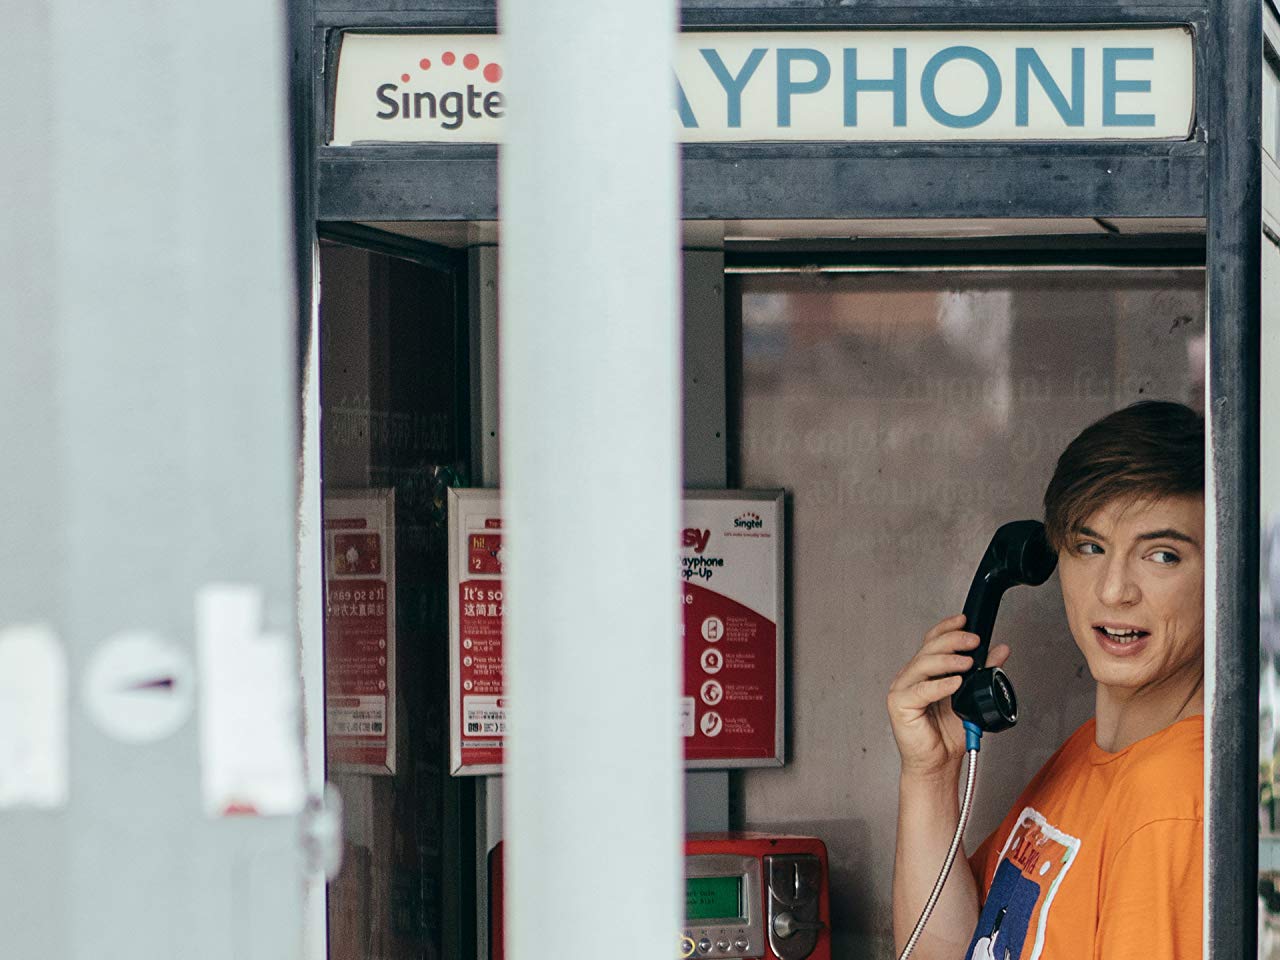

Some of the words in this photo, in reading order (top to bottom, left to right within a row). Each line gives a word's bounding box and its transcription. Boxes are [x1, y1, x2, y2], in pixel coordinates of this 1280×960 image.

[680, 46, 1156, 129] YPHONE
[375, 83, 505, 130] Singte
[733, 518, 763, 531] Singtel
[473, 537, 485, 548] hi!
[682, 528, 711, 554] sy
[681, 555, 724, 570] ayphone
[681, 567, 713, 581] op-Up
[464, 587, 484, 601] It's
[487, 591, 503, 601] so
